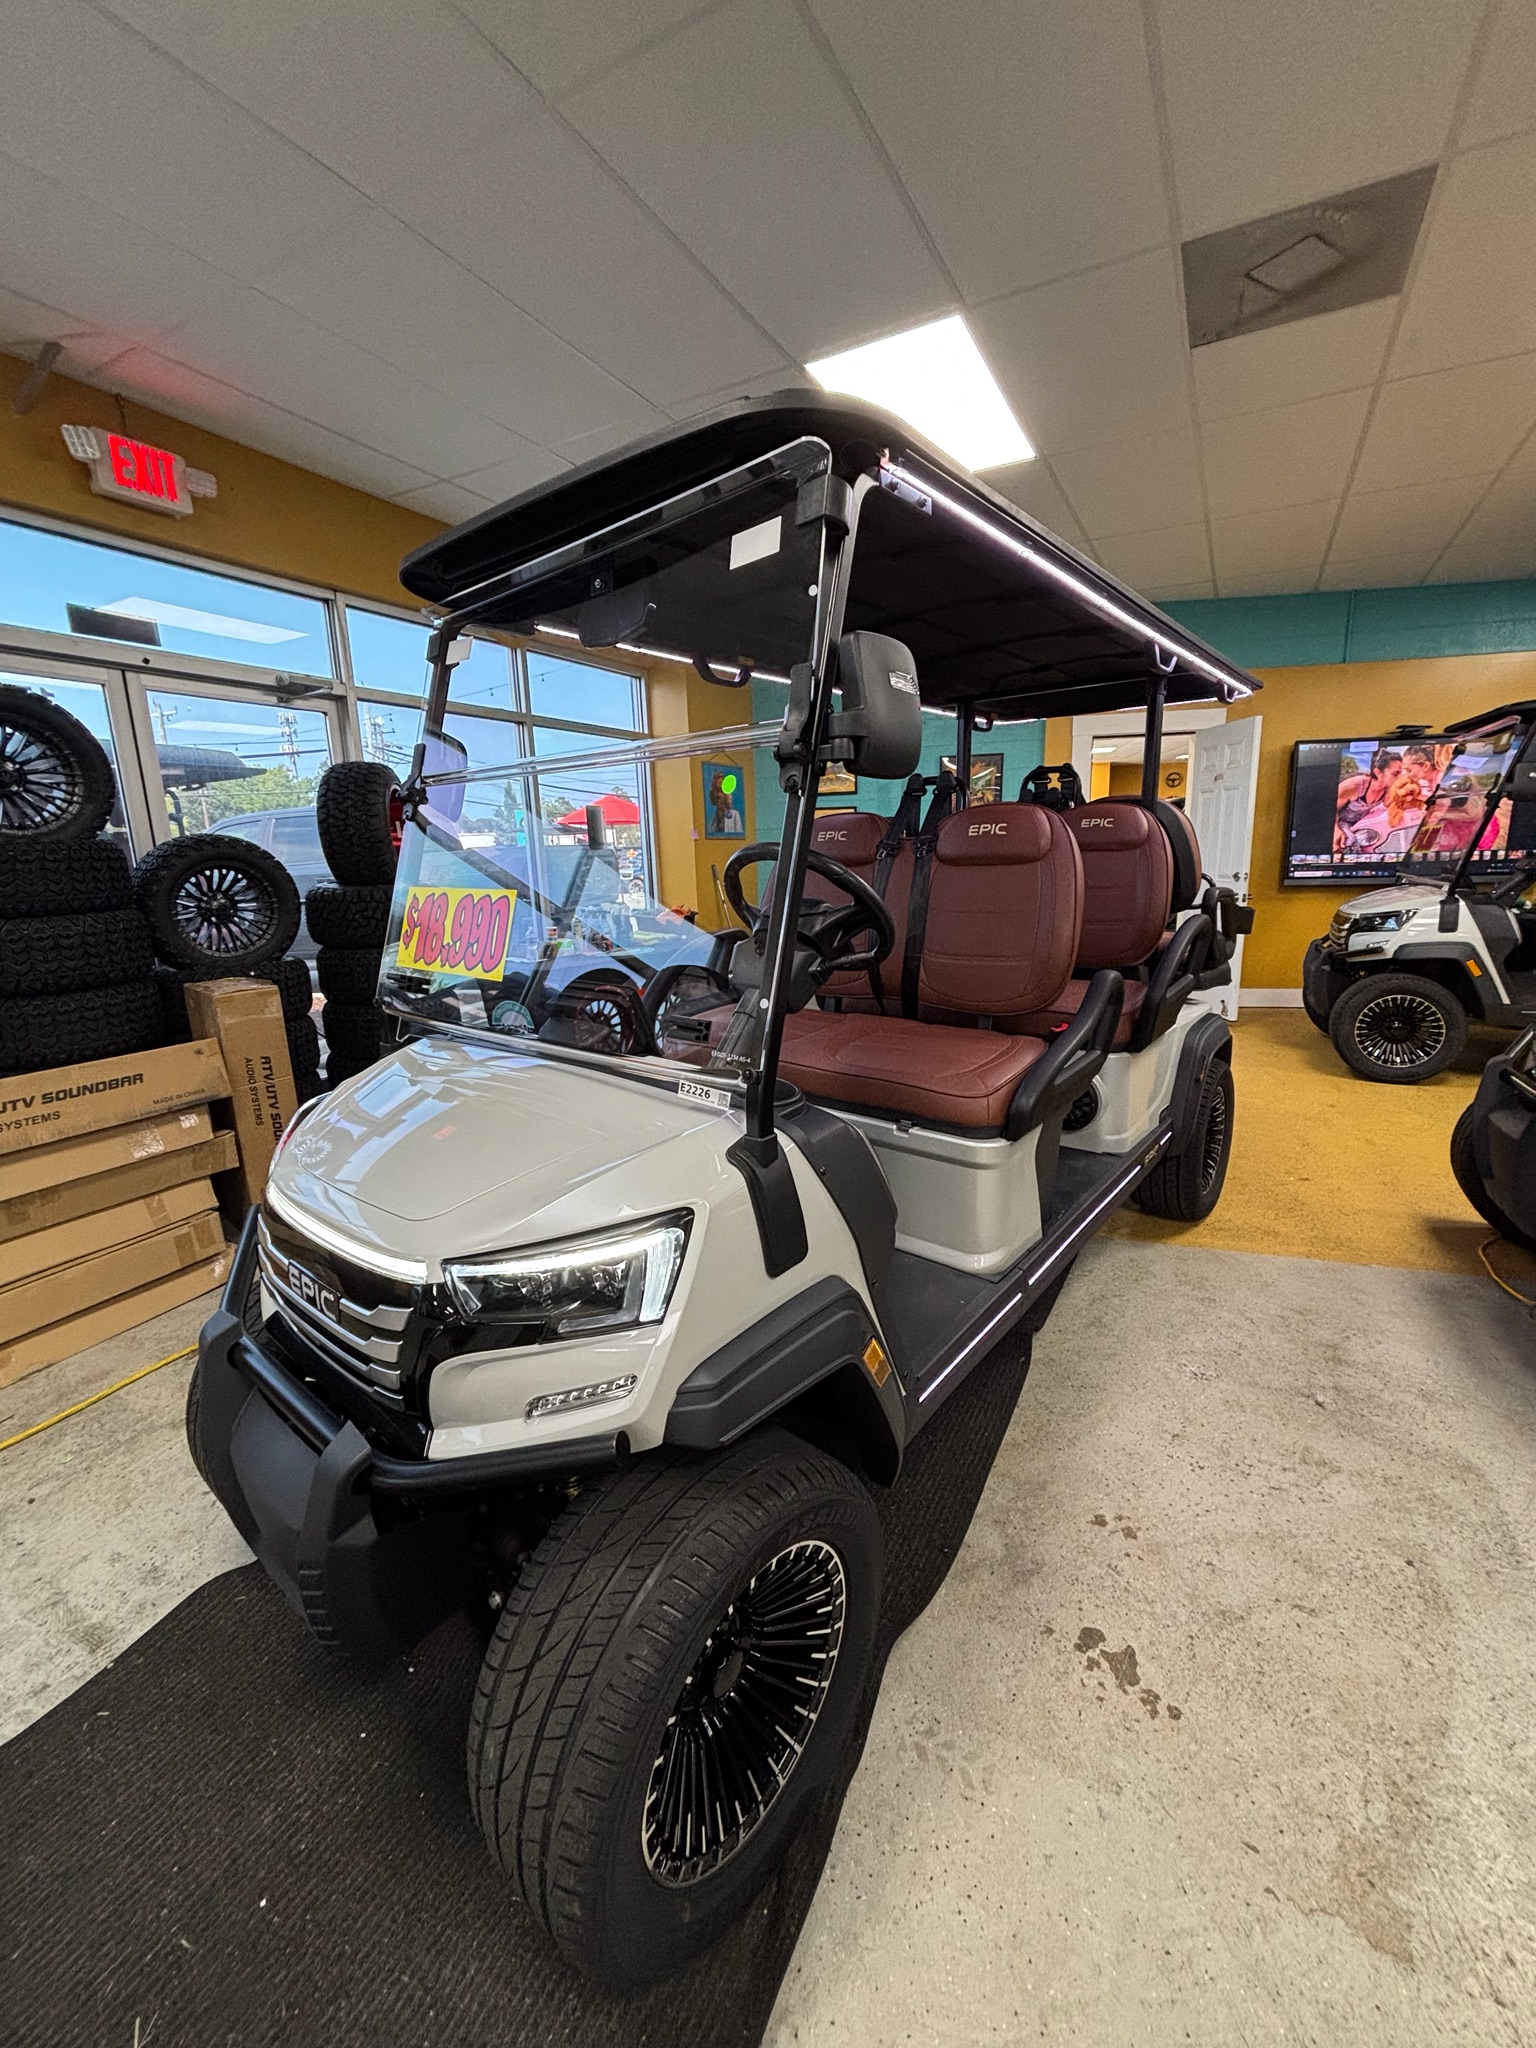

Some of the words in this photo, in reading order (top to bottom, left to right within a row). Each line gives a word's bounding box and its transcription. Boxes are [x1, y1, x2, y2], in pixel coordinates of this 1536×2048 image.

[107, 434, 178, 502] EXIT
[817, 830, 847, 842] EPIC
[968, 823, 1007, 836] EPIC
[1081, 818, 1114, 828] EPIC
[244, 1057, 256, 1085] AUDIO
[260, 1056, 280, 1110] ATV/UTV
[41, 1073, 144, 1105] SOUNDBAR
[153, 1095, 175, 1105] MADE
[680, 1082, 711, 1100] E2226
[249, 1086, 264, 1126] SYSTEMS
[288, 1265, 337, 1322] EPIC
